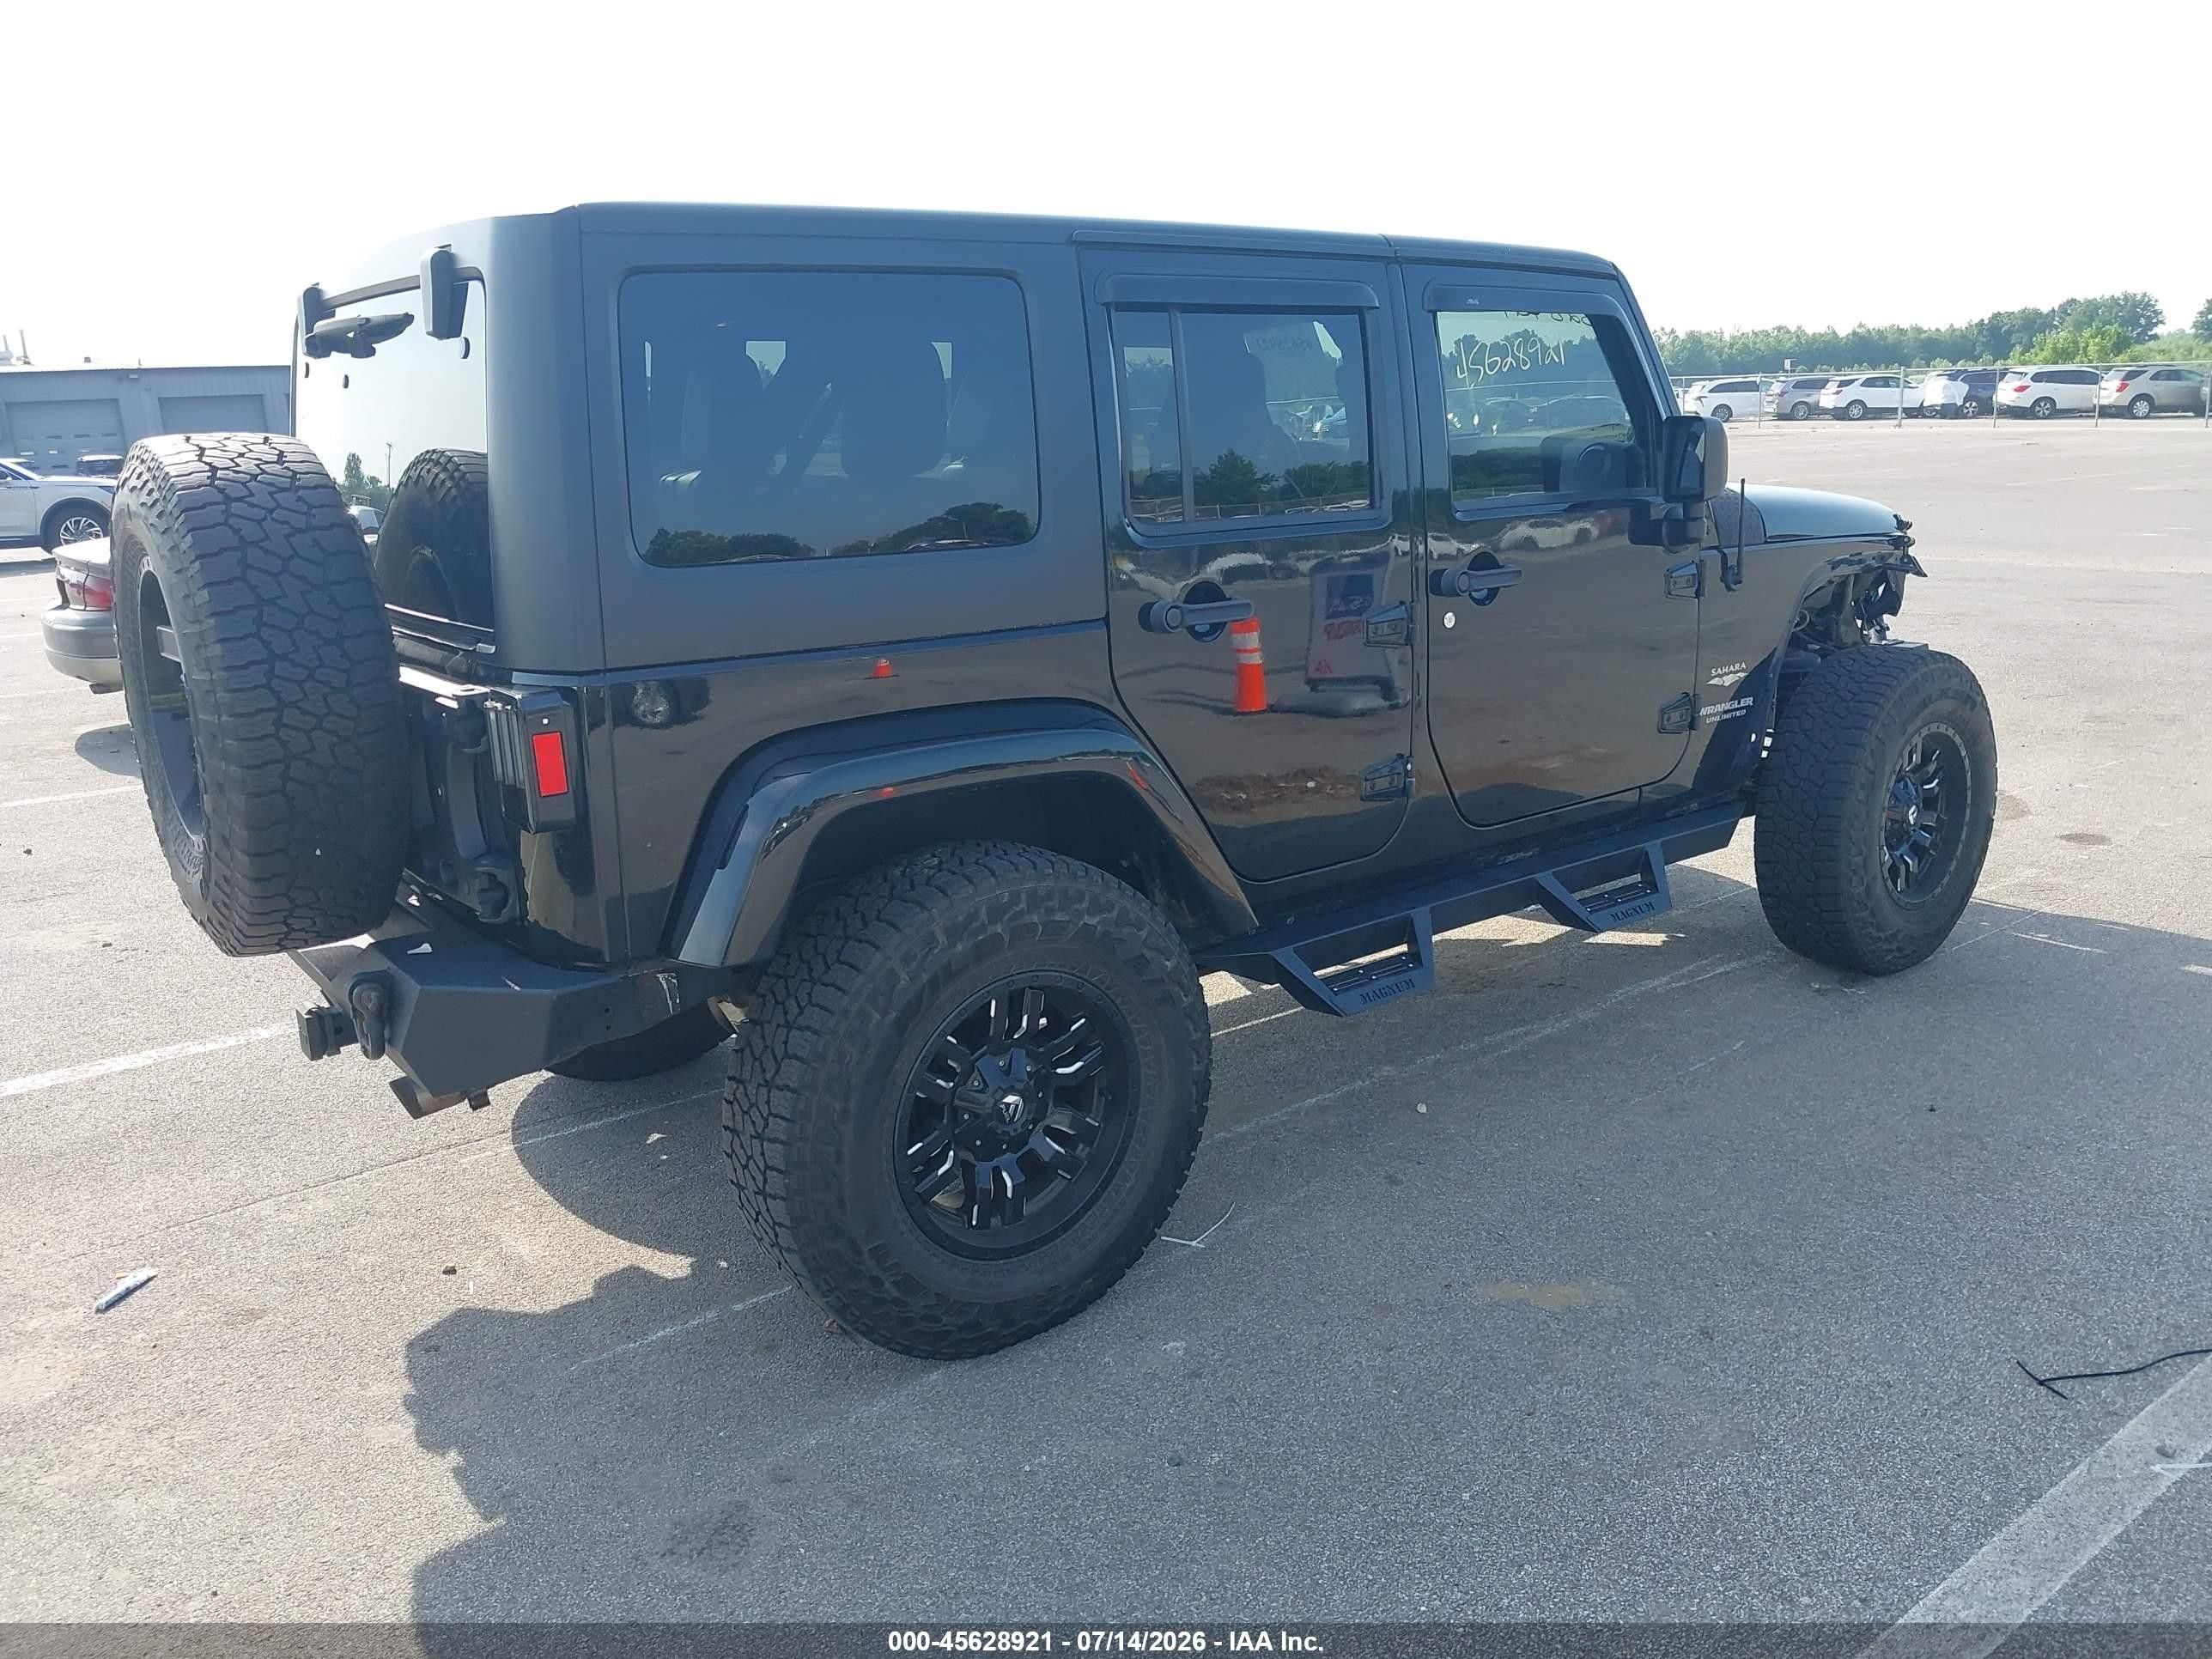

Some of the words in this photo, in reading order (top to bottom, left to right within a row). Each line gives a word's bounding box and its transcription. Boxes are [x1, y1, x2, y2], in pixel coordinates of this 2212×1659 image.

[1456, 337, 1566, 389] 45628921
[1711, 662, 1747, 677] SAHARA
[1705, 709, 1746, 724] UNLIMITED
[1610, 902, 1656, 923] MAGNUM
[1359, 978, 1416, 1006] MAGNUM
